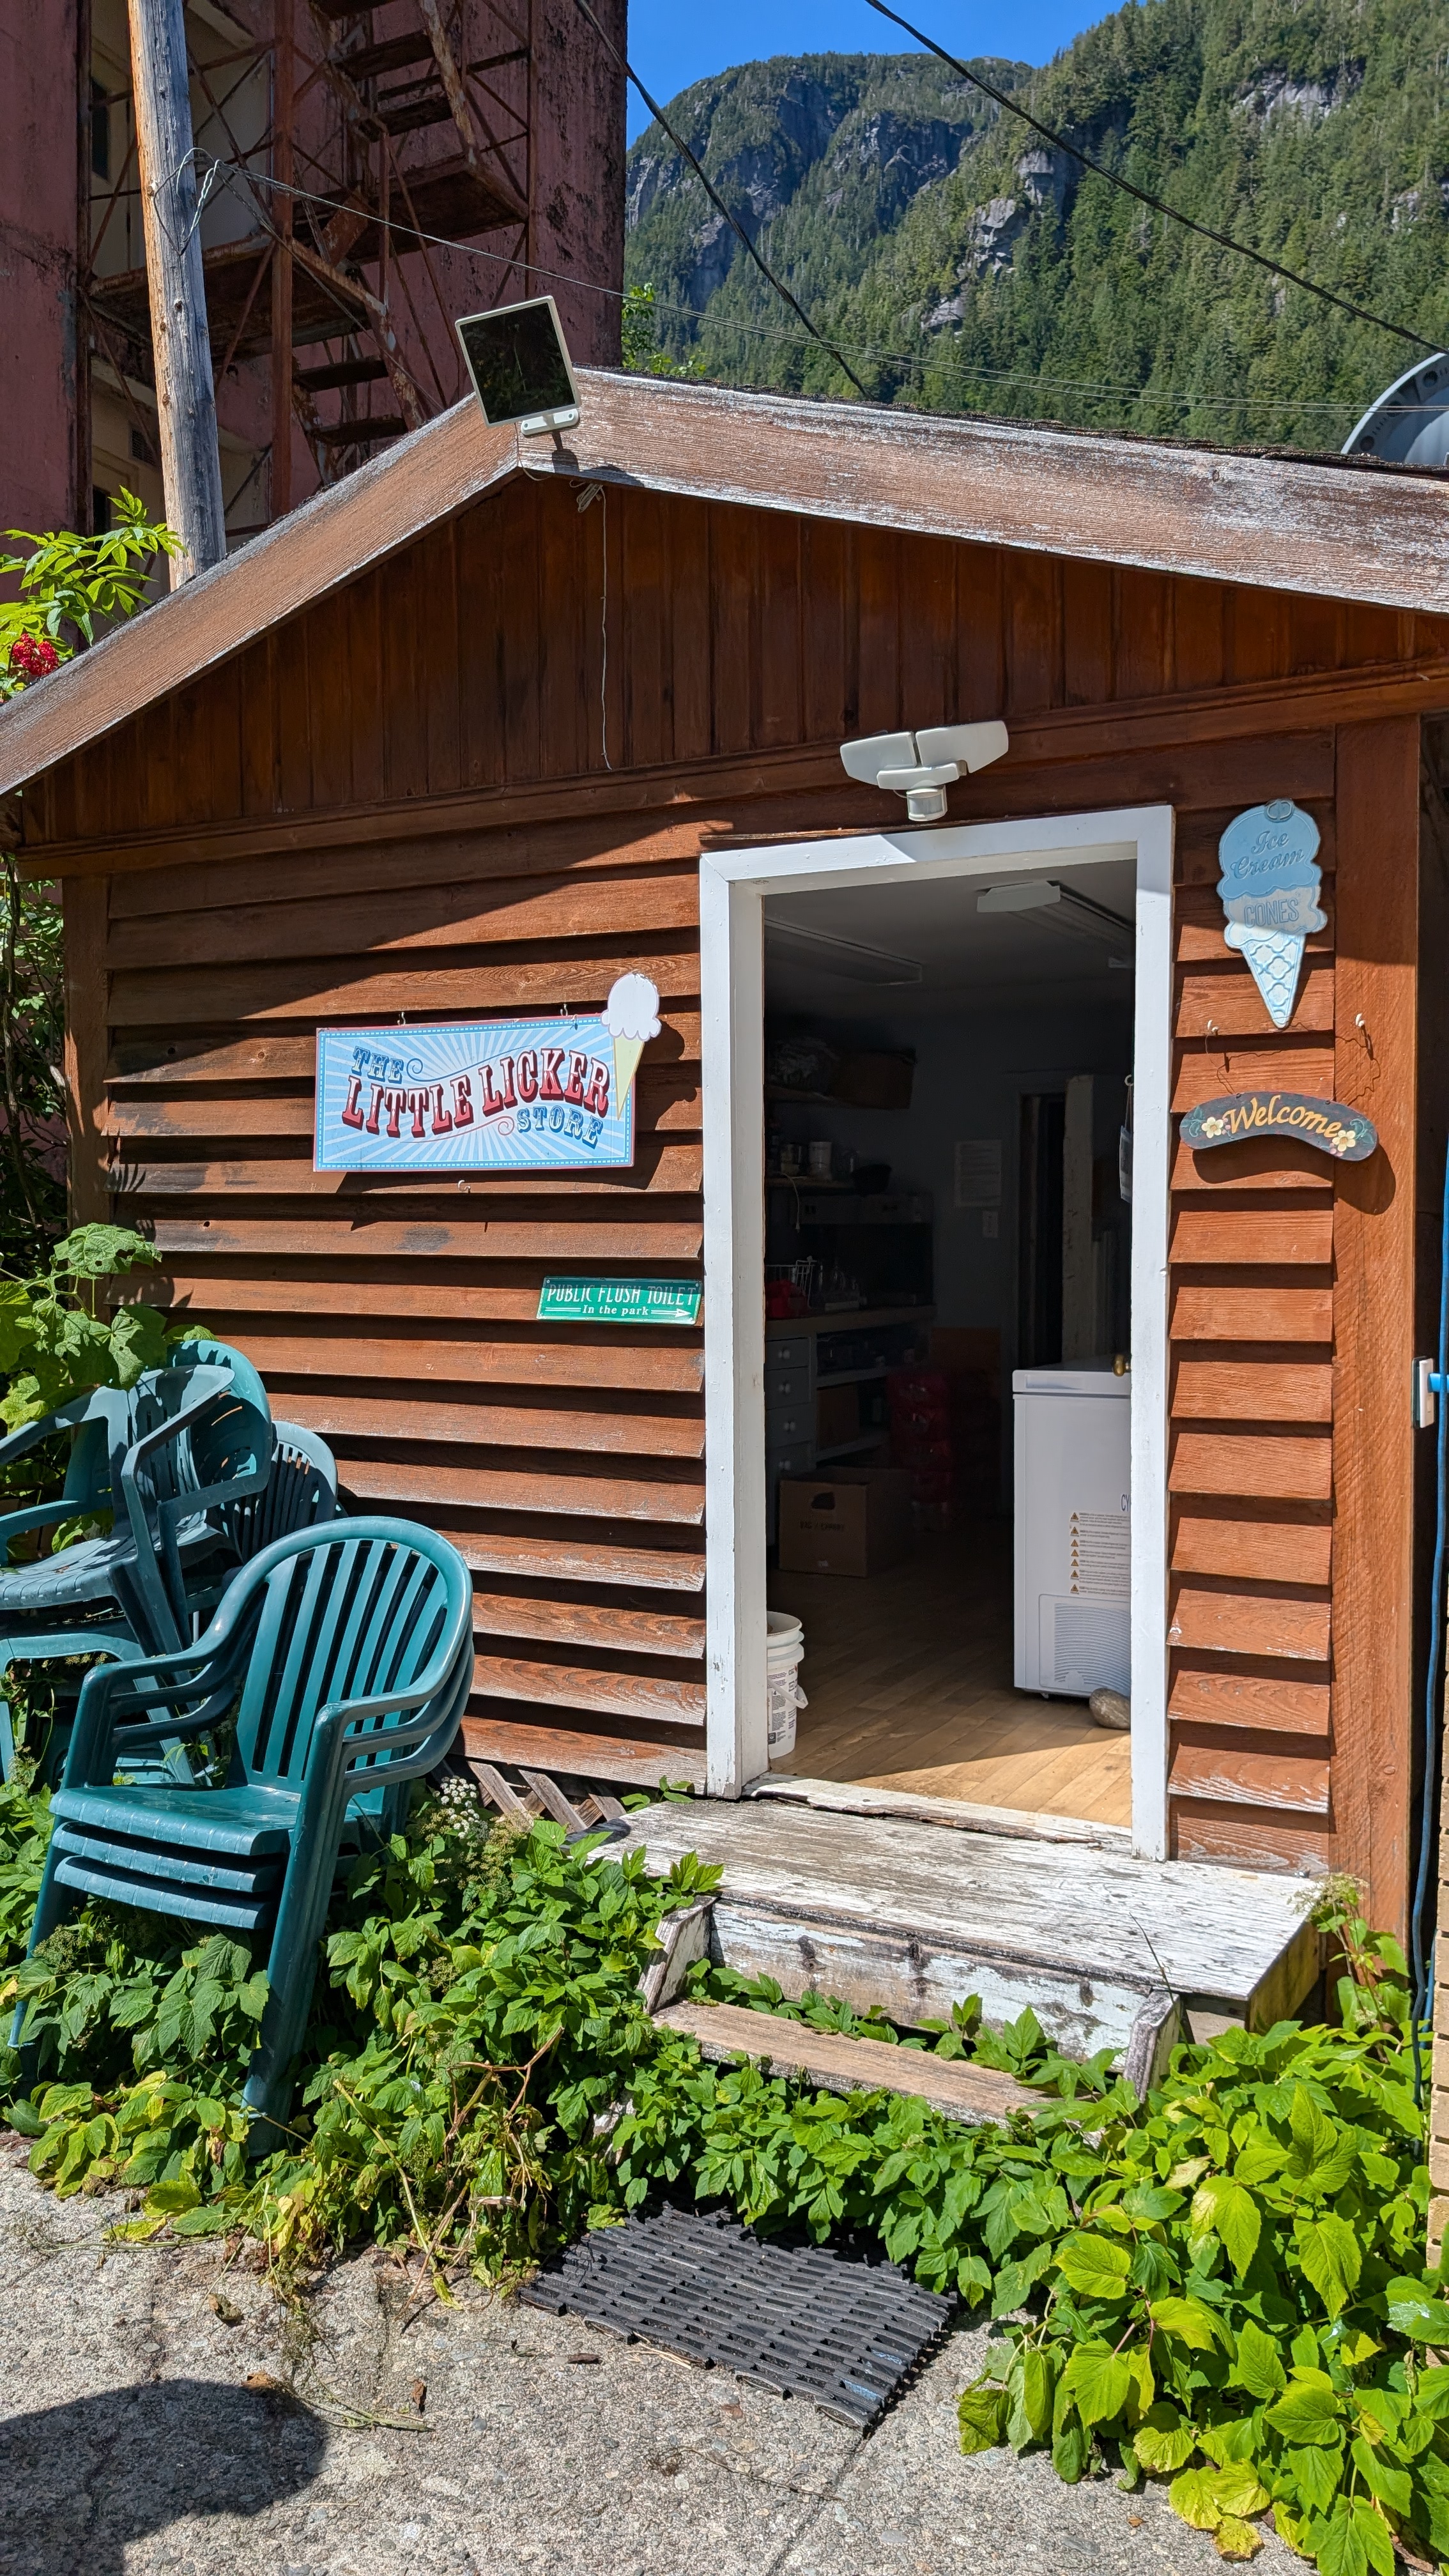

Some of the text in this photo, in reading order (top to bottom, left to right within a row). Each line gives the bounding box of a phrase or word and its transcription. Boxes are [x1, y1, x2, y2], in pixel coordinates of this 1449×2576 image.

[1251, 830, 1289, 855] Ice
[1230, 848, 1305, 880] Cream
[1243, 898, 1300, 929] CONES
[352, 1045, 404, 1084] THE
[342, 1048, 610, 1138] LITTLE LICKER
[517, 1105, 604, 1149] STORE
[1223, 1095, 1342, 1138] Welcome
[547, 1284, 696, 1305] PUBLIC FLUSH TOILET
[583, 1305, 649, 1316] In the park
